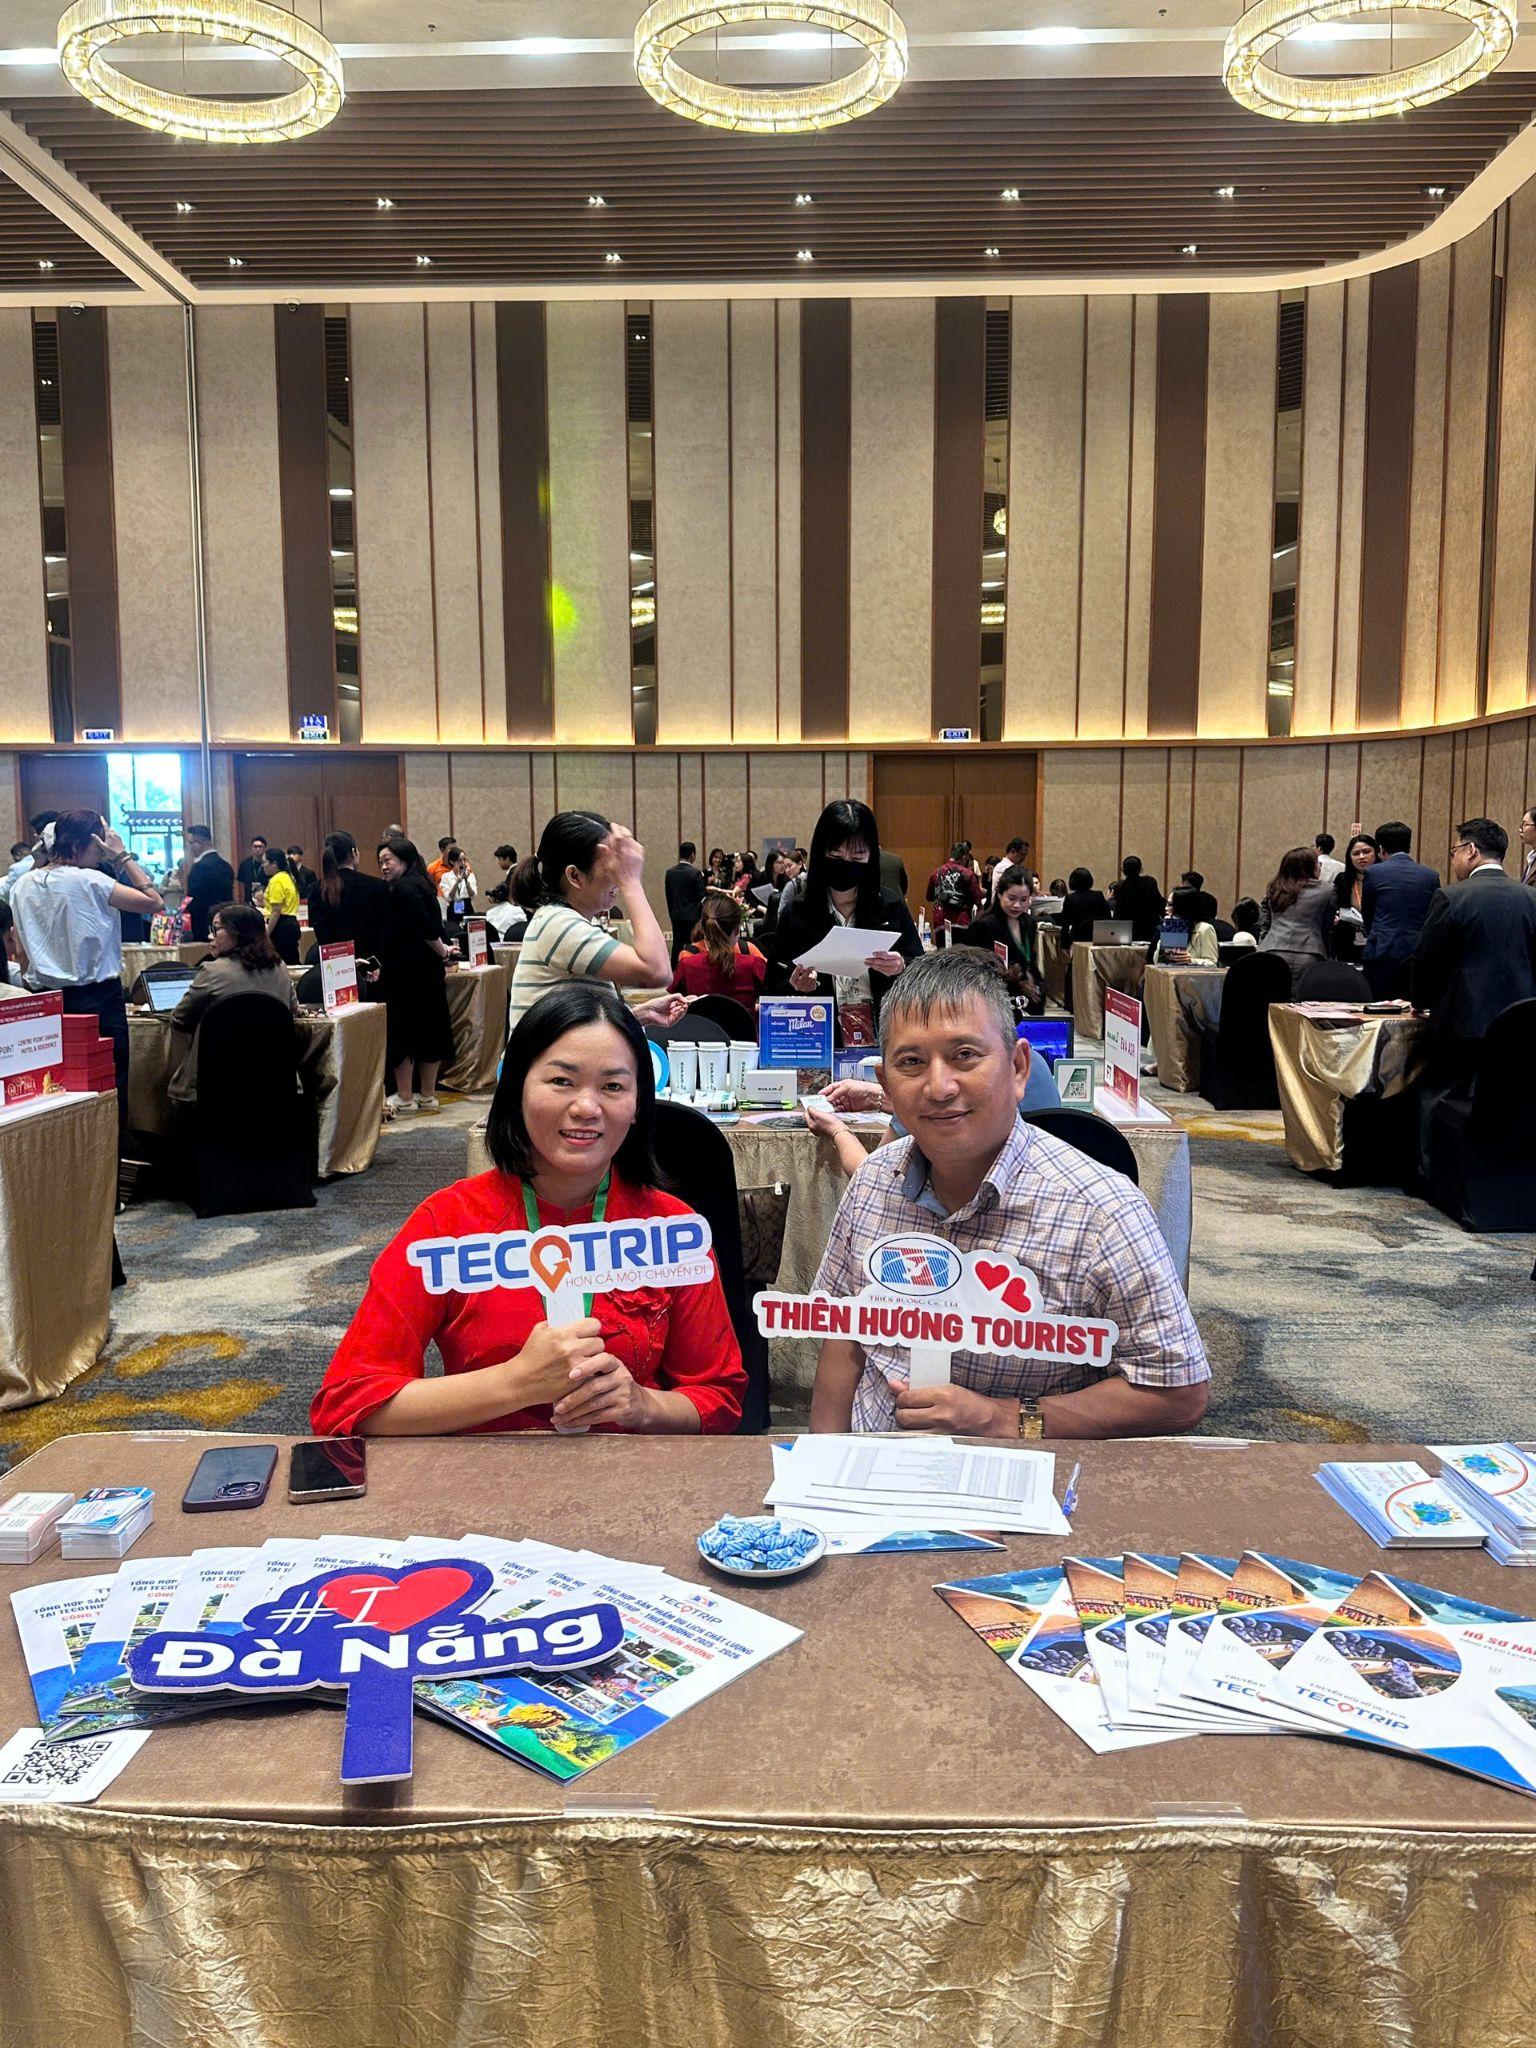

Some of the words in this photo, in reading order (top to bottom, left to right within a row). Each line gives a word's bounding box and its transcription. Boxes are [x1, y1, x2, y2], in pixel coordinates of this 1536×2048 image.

[788, 1017, 815, 1031] Milan
[416, 1222, 703, 1293] TECOTRIP
[565, 1275, 592, 1288] HƠN
[595, 1272, 614, 1285] CẢ
[616, 1270, 642, 1284] MỘT
[645, 1264, 692, 1281] CHUYẾN
[694, 1265, 706, 1276] ĐI
[761, 1297, 851, 1335] THIÊN
[858, 1305, 964, 1343] HƯƠNG
[971, 1315, 1110, 1358] TOURIST
[525, 1567, 539, 1576] HỢ
[574, 1578, 587, 1588] HỢ
[605, 1595, 642, 1613] TECOTRIP
[692, 1635, 716, 1649] 2025
[659, 1594, 723, 1624] TECOTRIP
[151, 1636, 302, 1678] Đà
[339, 1613, 603, 1674] Nẵng
[1295, 1684, 1410, 1730] TECOTRIP
